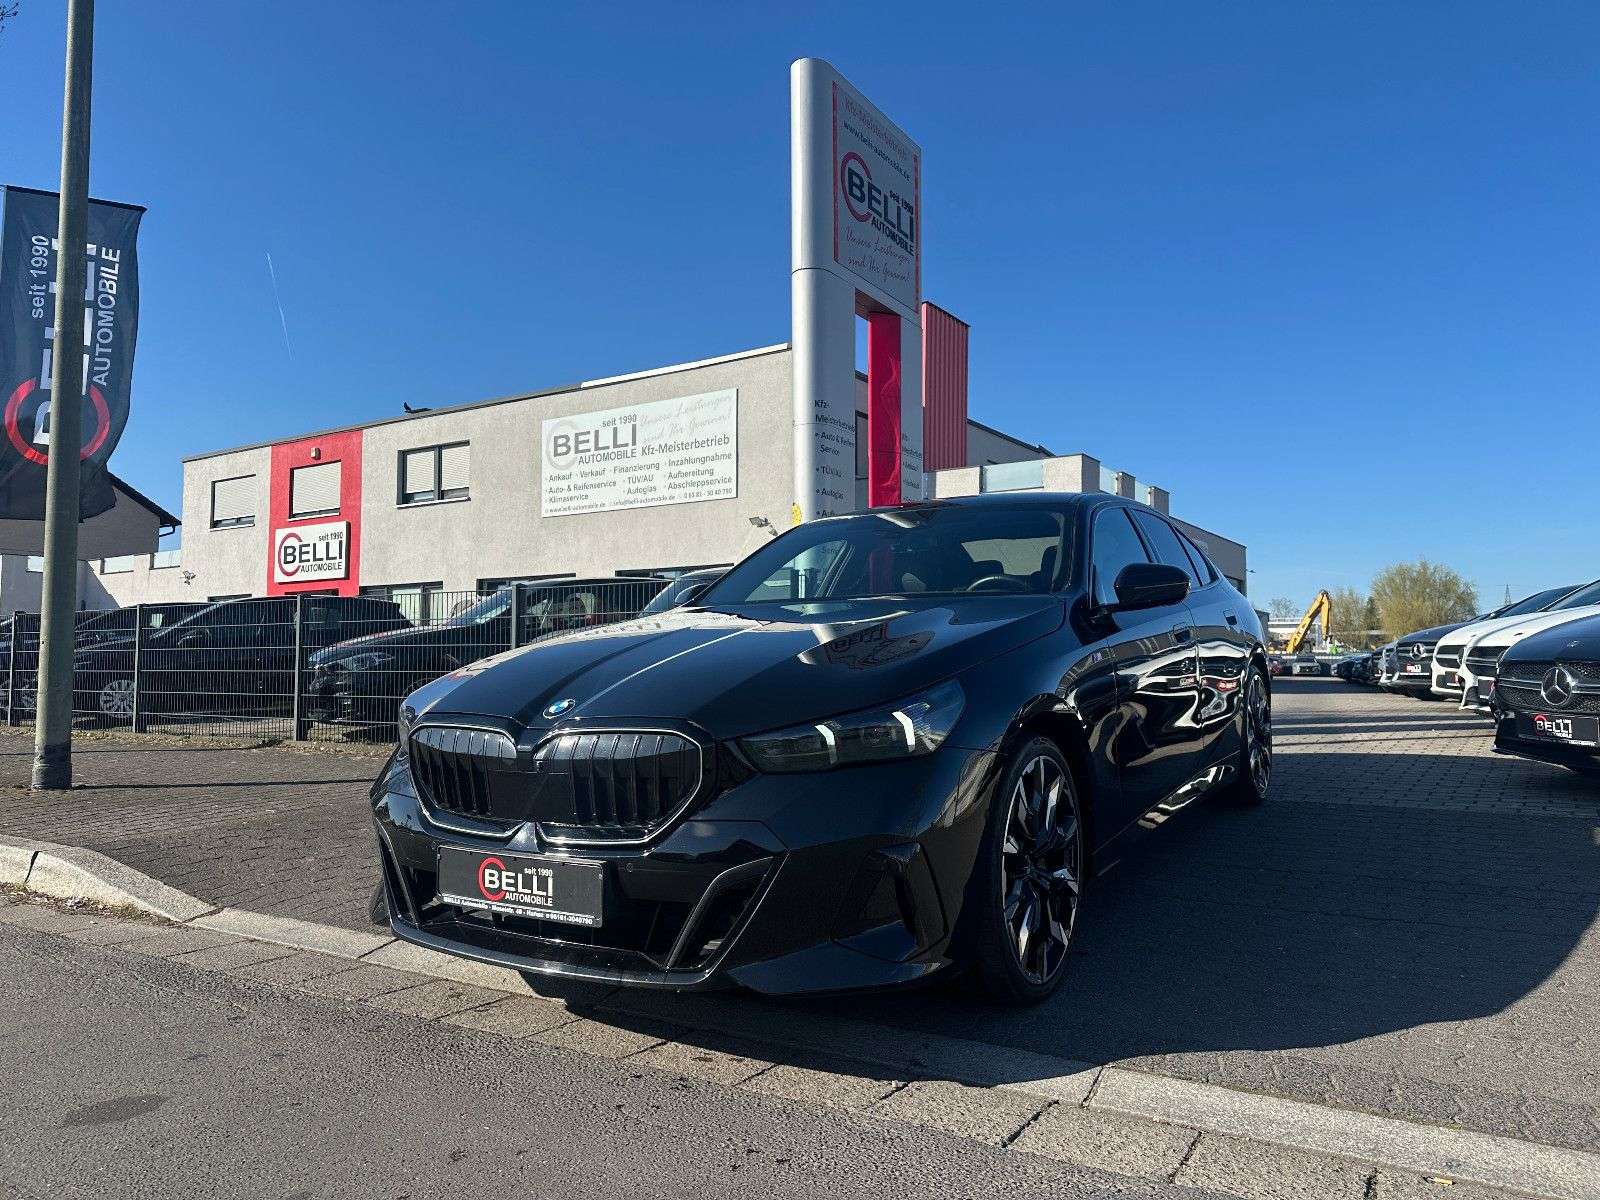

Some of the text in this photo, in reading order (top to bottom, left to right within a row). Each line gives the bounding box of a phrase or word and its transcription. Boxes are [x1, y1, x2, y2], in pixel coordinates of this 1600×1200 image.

[848, 167, 914, 243] BELLI
[871, 216, 914, 256] AUTOMOBILE
[28, 235, 49, 319] seit 1990
[92, 246, 120, 387] AUTOMOBILE
[602, 414, 637, 428] seit 1990
[553, 424, 637, 458] BELLI
[641, 434, 730, 456] Kfz-Meisterbetrieb
[578, 449, 637, 466] AUTOMOBILE
[668, 452, 732, 467] Inzahlungnahme
[580, 468, 606, 478] Verkauf
[613, 462, 660, 475] Finanzierung
[668, 468, 714, 480] Aufbereitung
[549, 472, 572, 482] Ankauf
[283, 540, 343, 564] BELLI
[300, 562, 342, 573] AUTOMOBILE
[524, 867, 553, 877] seit 1990
[484, 868, 553, 896] BELLI
[505, 892, 553, 907] AUTOMOBILE
